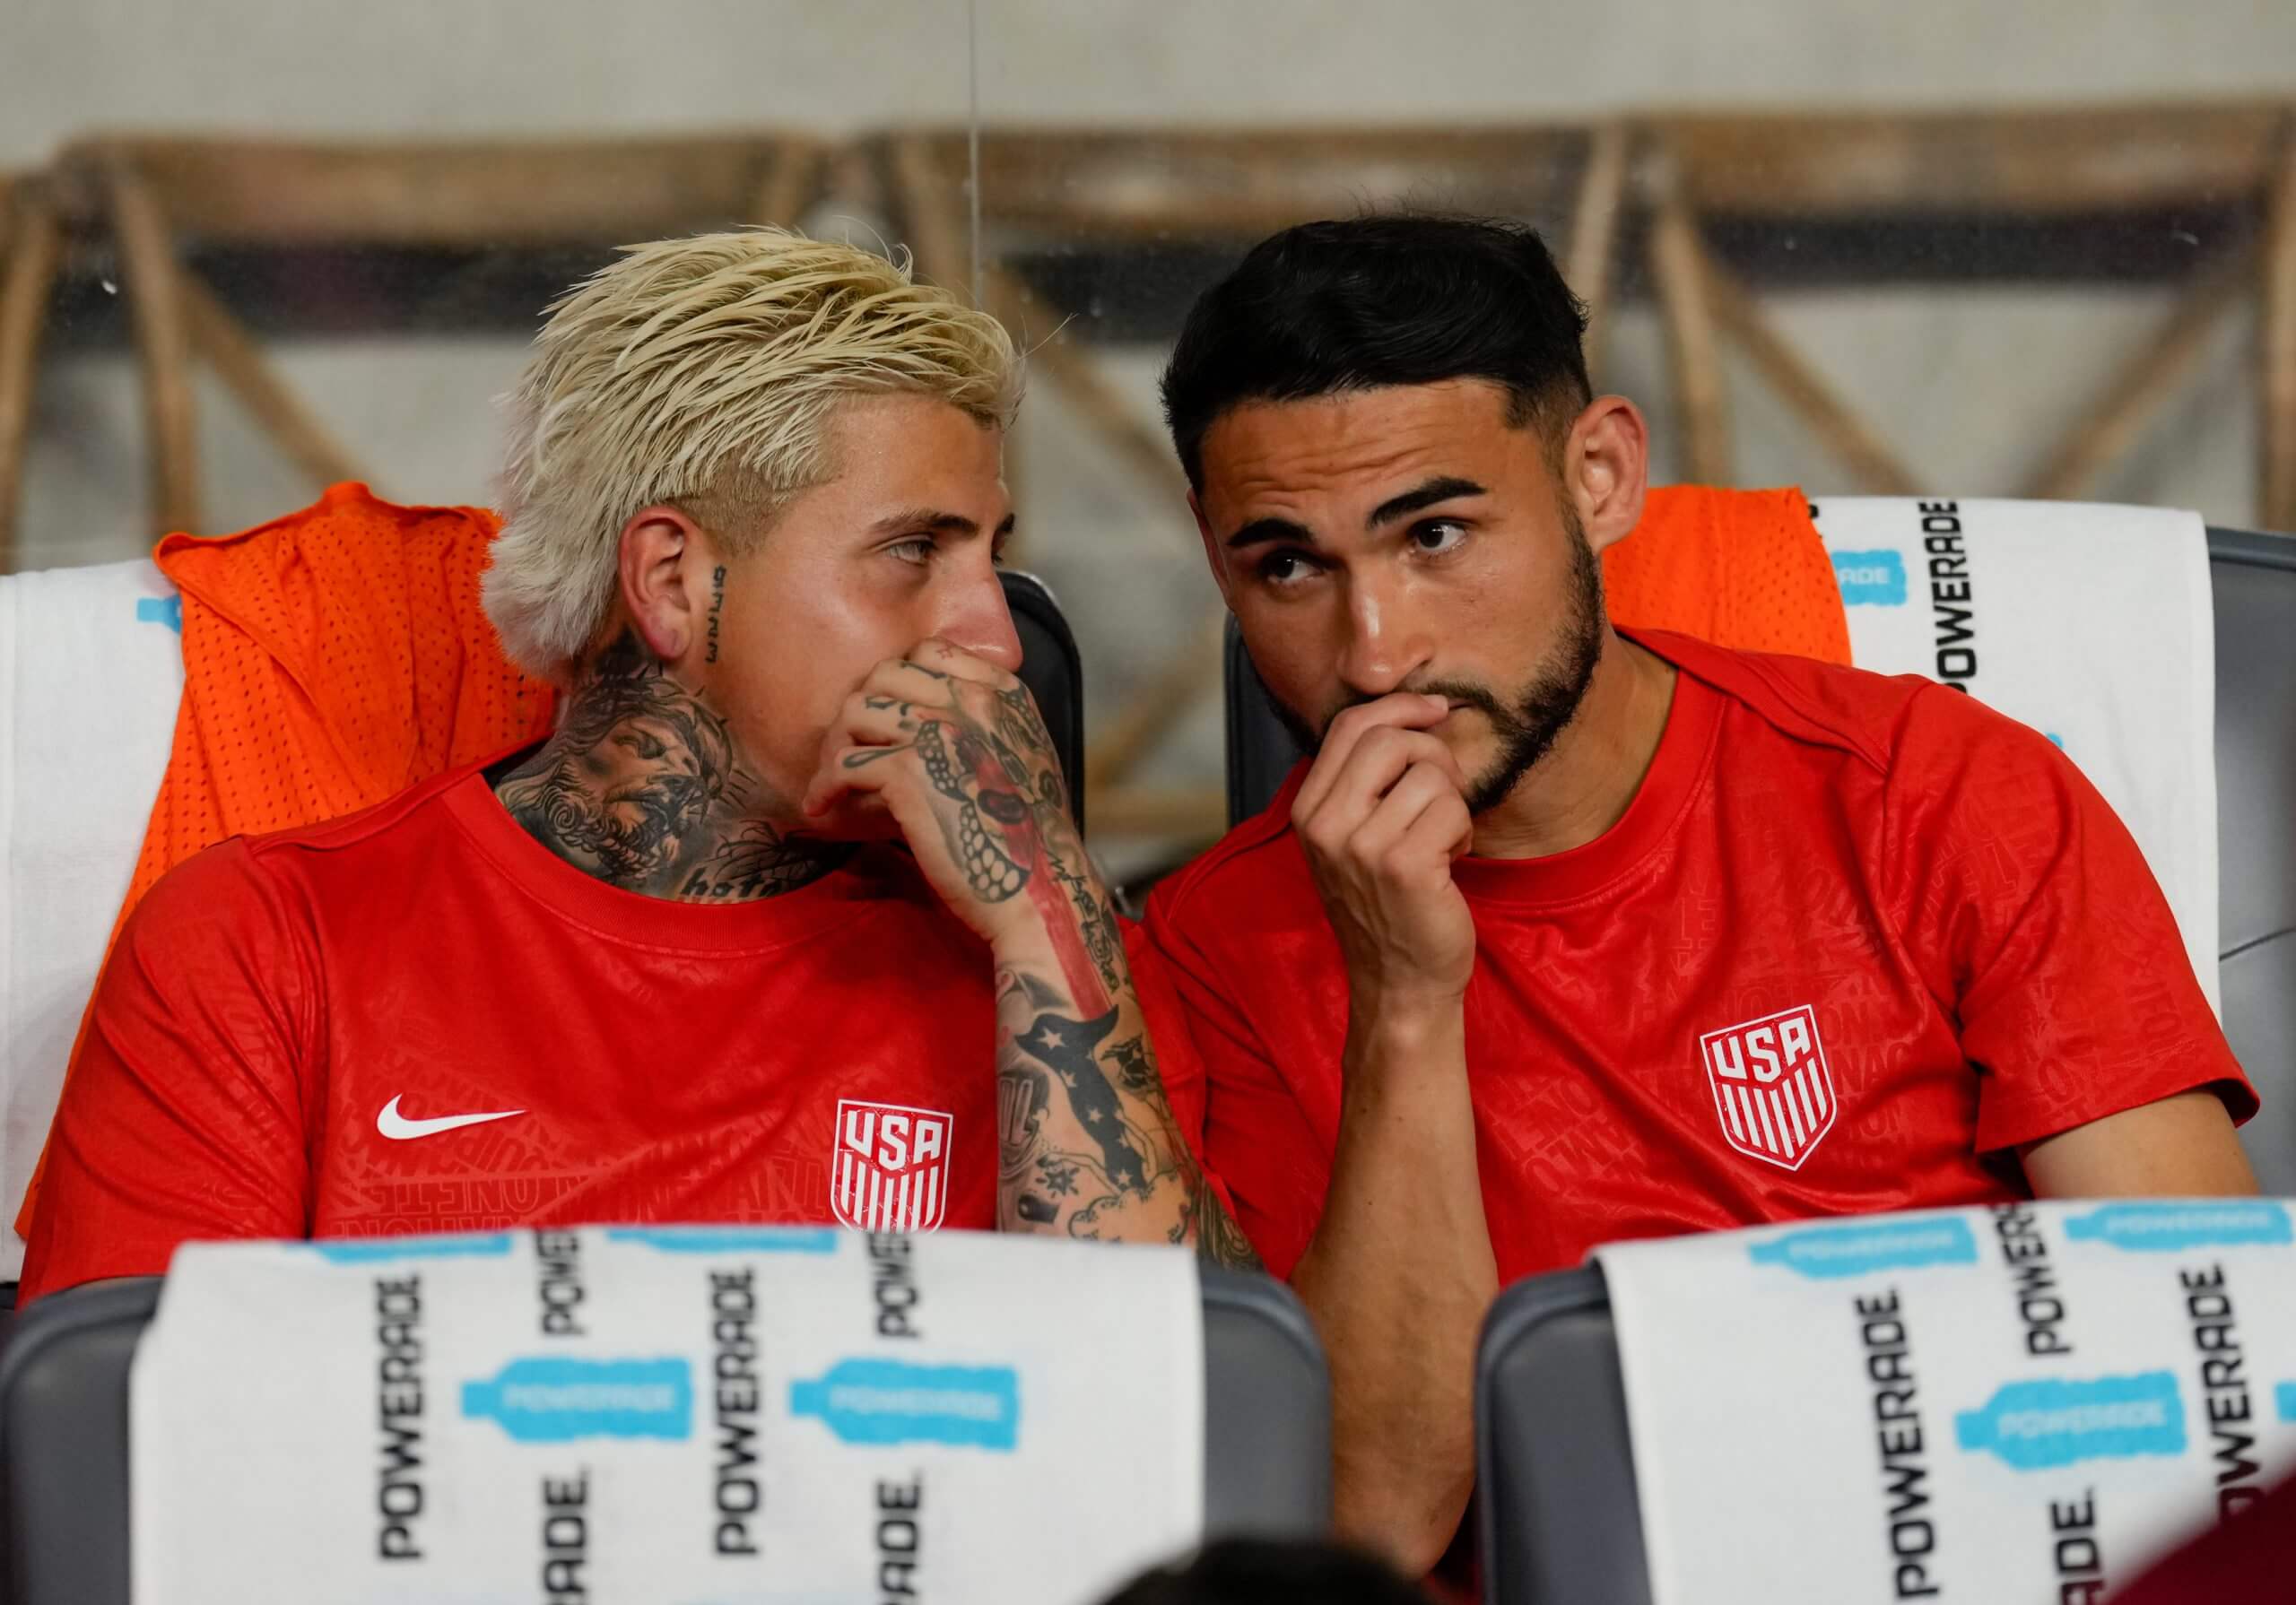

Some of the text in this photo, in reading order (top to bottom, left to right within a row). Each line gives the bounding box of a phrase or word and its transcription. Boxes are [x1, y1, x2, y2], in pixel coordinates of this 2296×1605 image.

[845, 1109, 944, 1171] USA
[1711, 1016, 1812, 1083] USA
[376, 1274, 425, 1561] POWERADE
[709, 1268, 761, 1557] POWERADE
[1854, 1288, 1940, 1601] POWERADE
[2179, 1263, 2266, 1523] OWERADE
